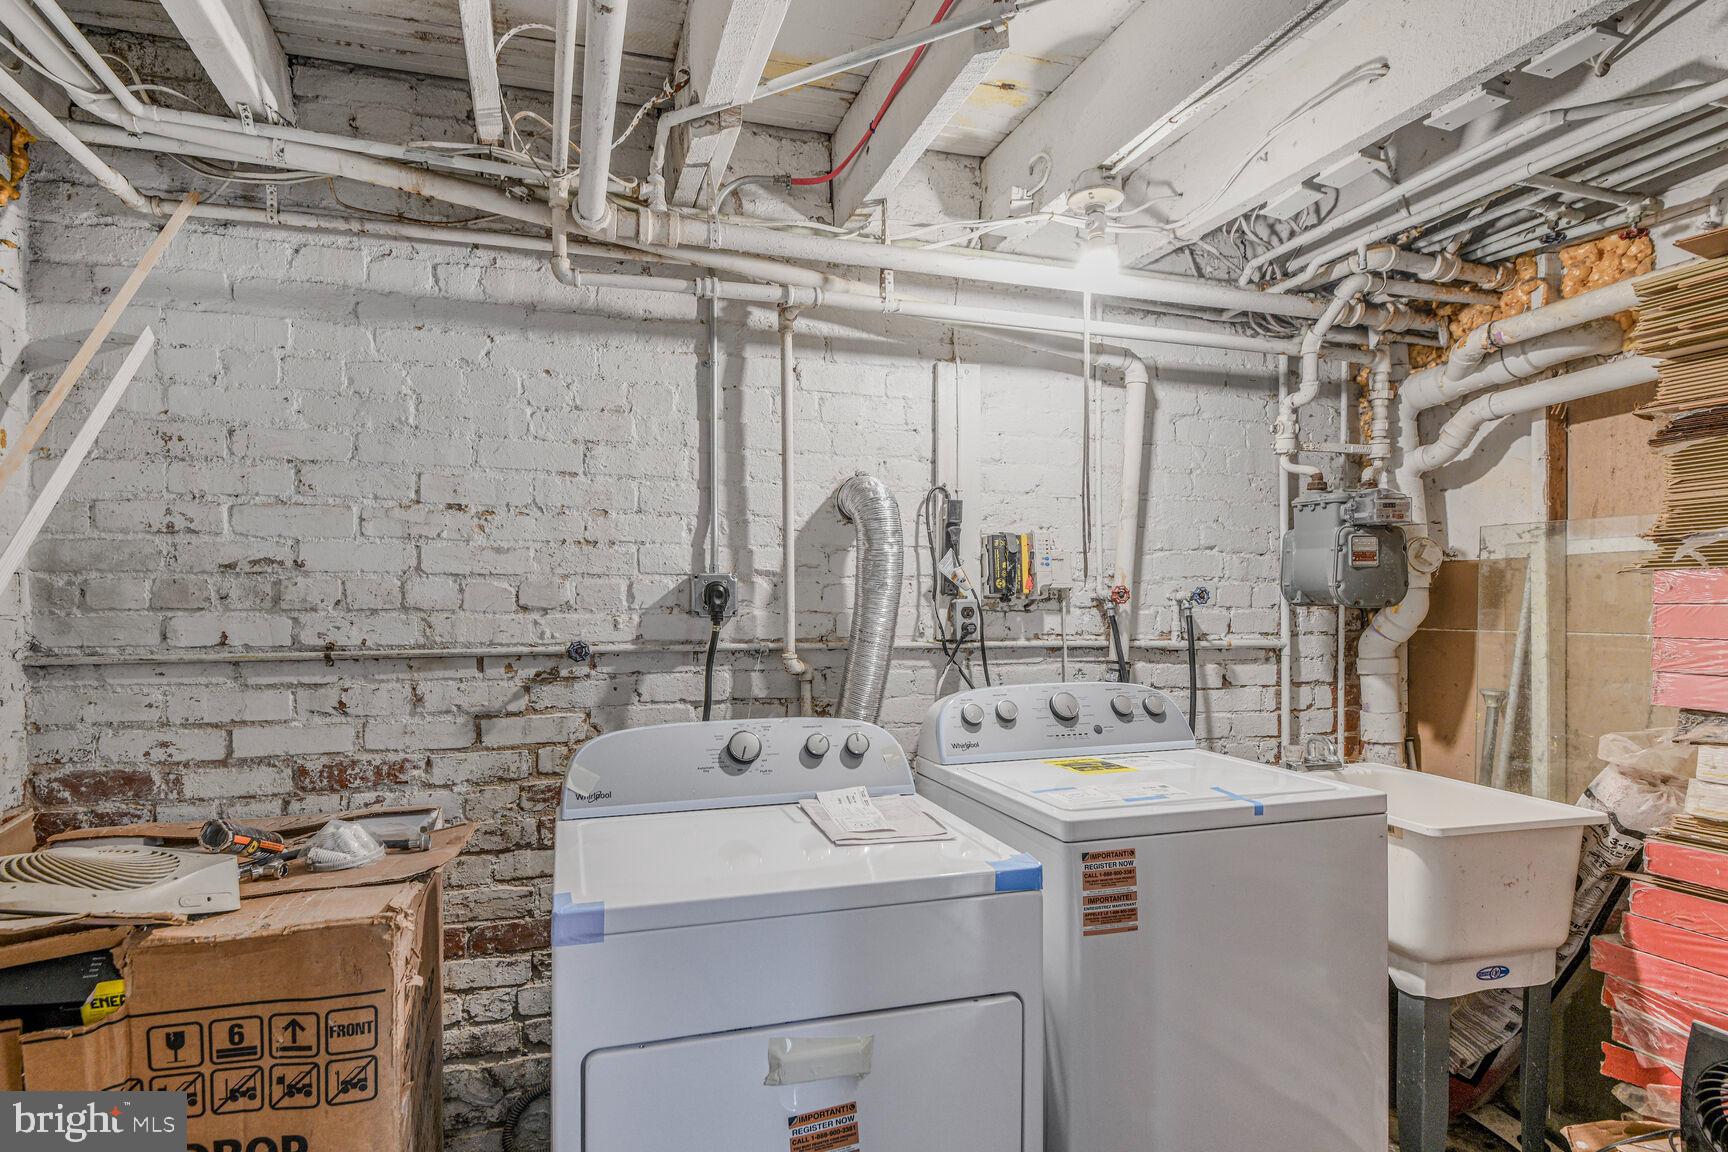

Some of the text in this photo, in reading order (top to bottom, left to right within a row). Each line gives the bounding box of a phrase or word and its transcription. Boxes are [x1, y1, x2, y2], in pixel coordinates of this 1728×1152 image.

[951, 741, 980, 752] Whirlpool
[1090, 850, 1128, 860] IMPORTANT!
[1084, 862, 1117, 870] REGISTER
[1088, 894, 1132, 904] IMPORTANTE!
[228, 1020, 374, 1046] 6 FRONT
[799, 1106, 848, 1123] IMPORTANT!
[792, 1115, 855, 1136] REGISTER NOW
[792, 1137, 809, 1145] CALL
